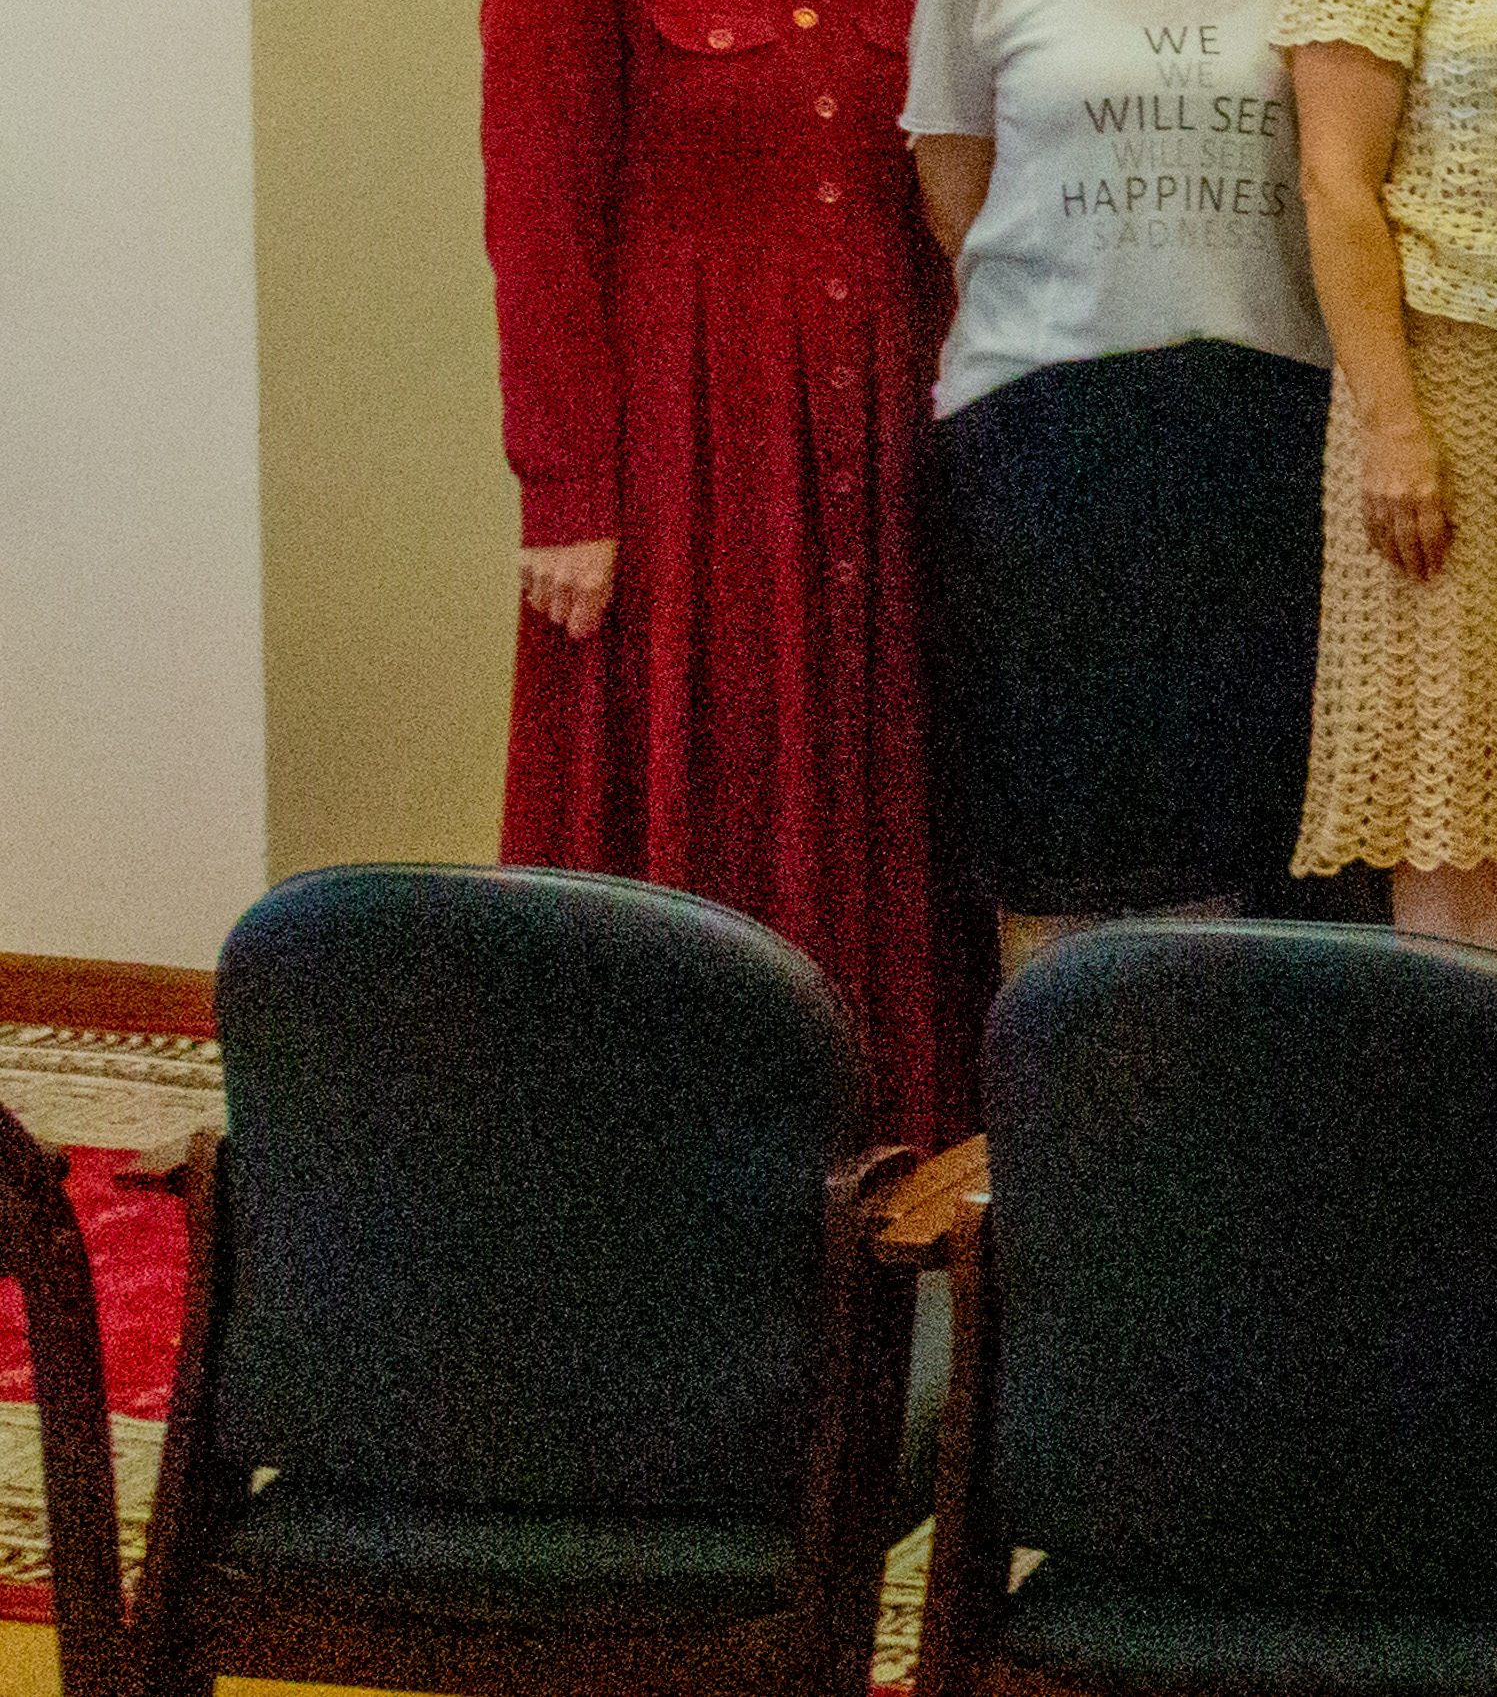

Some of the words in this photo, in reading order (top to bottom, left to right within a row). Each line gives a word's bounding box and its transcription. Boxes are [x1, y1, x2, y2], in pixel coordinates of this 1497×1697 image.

[1143, 24, 1221, 56] WE
[1156, 60, 1214, 89] WE
[1083, 95, 1196, 134] WILL
[1210, 95, 1282, 138] SEE
[1111, 138, 1192, 171] WILL
[1198, 139, 1259, 172] SEE
